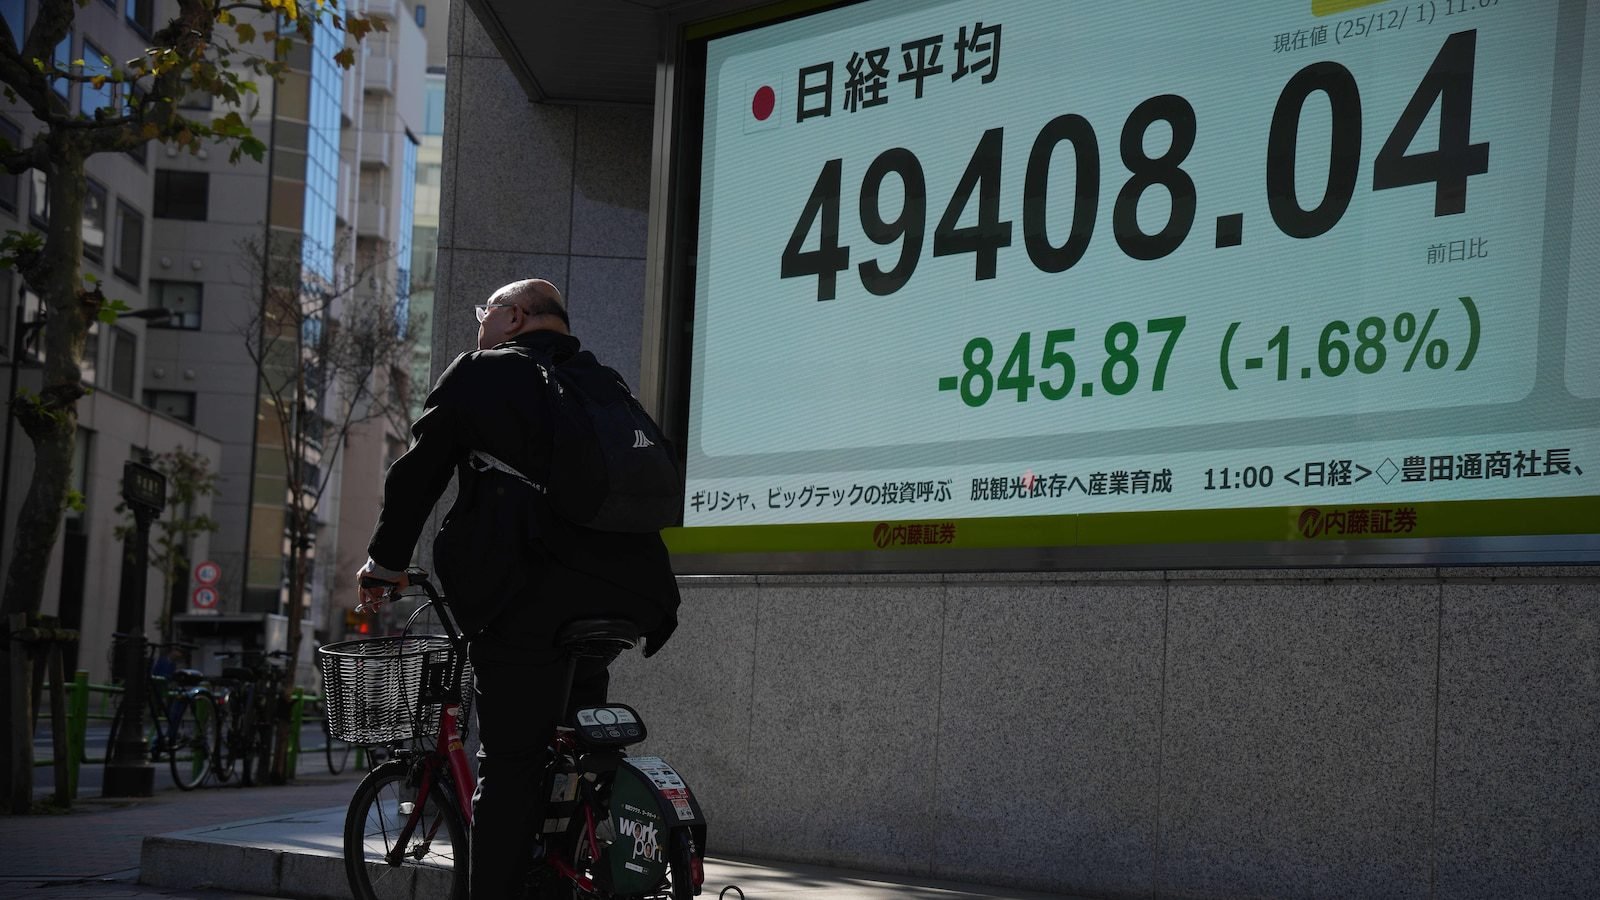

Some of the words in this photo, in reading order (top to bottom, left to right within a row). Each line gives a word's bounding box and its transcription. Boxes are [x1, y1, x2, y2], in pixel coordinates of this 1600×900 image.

[1273, 24, 1328, 53] 現在値
[796, 22, 1003, 124] 日経平均
[780, 28, 1491, 302] 49408.04
[1427, 237, 1488, 265] 前日比
[938, 315, 1187, 408] -845.87
[1219, 296, 1481, 390] (-1.68%)
[690, 479, 953, 513] ギリシャ、ビッグテックの投資呼ぶ
[970, 468, 1173, 502] 脱観光依存へ産業育成
[1204, 466, 1274, 491] 11:00
[891, 522, 956, 545] 内藤証券
[1324, 506, 1417, 535] 内藤証券
[619, 817, 659, 847] work
